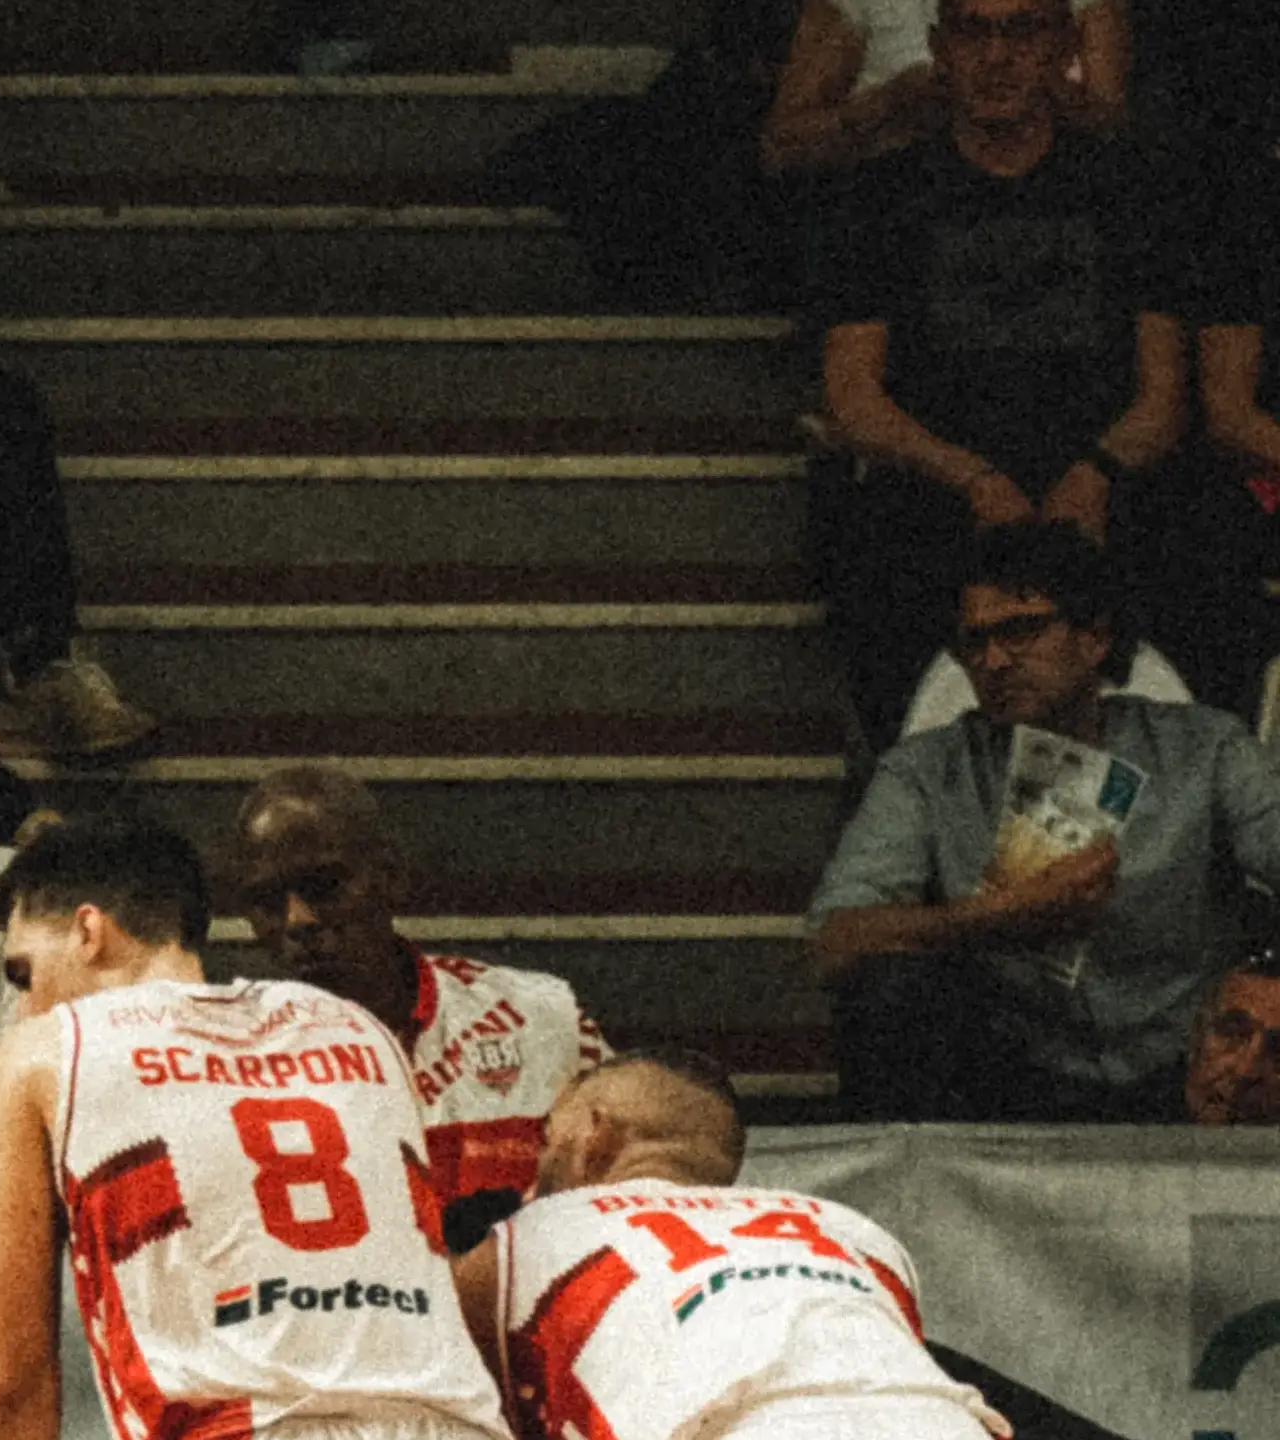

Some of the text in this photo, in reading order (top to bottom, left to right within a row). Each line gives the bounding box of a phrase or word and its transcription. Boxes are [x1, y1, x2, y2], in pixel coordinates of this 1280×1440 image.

[131, 1043, 389, 1089] SCARPONI
[230, 1097, 370, 1252] 8
[625, 1210, 862, 1273] 14
